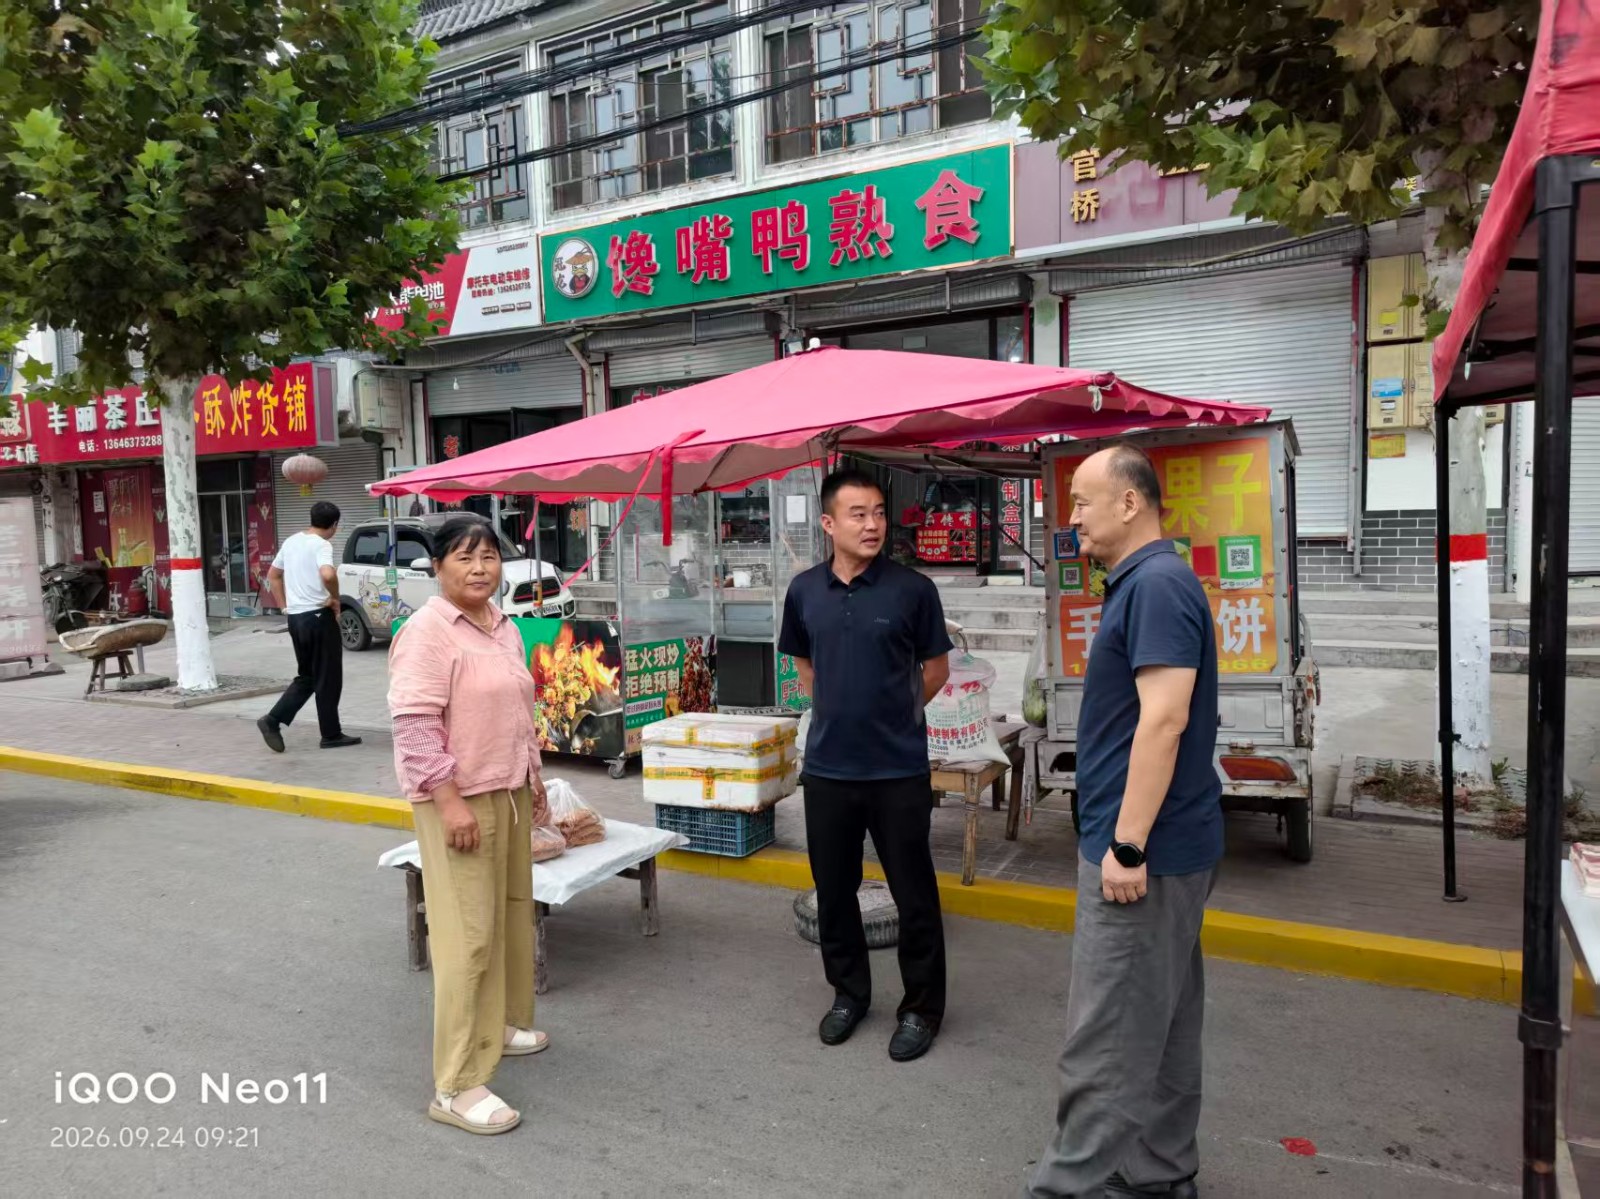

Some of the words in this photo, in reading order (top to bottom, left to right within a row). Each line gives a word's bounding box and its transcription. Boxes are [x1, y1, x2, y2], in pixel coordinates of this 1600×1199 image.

[1070, 148, 1100, 224] 官桥
[606, 169, 985, 299] 馋嘴鸭熟食
[194, 375, 307, 438] 酥炸货铺
[103, 434, 163, 450] 13646373288
[1001, 477, 1021, 546] 制盒饭
[624, 643, 680, 673] 猛火现炒
[625, 667, 680, 699] 拒绝预制
